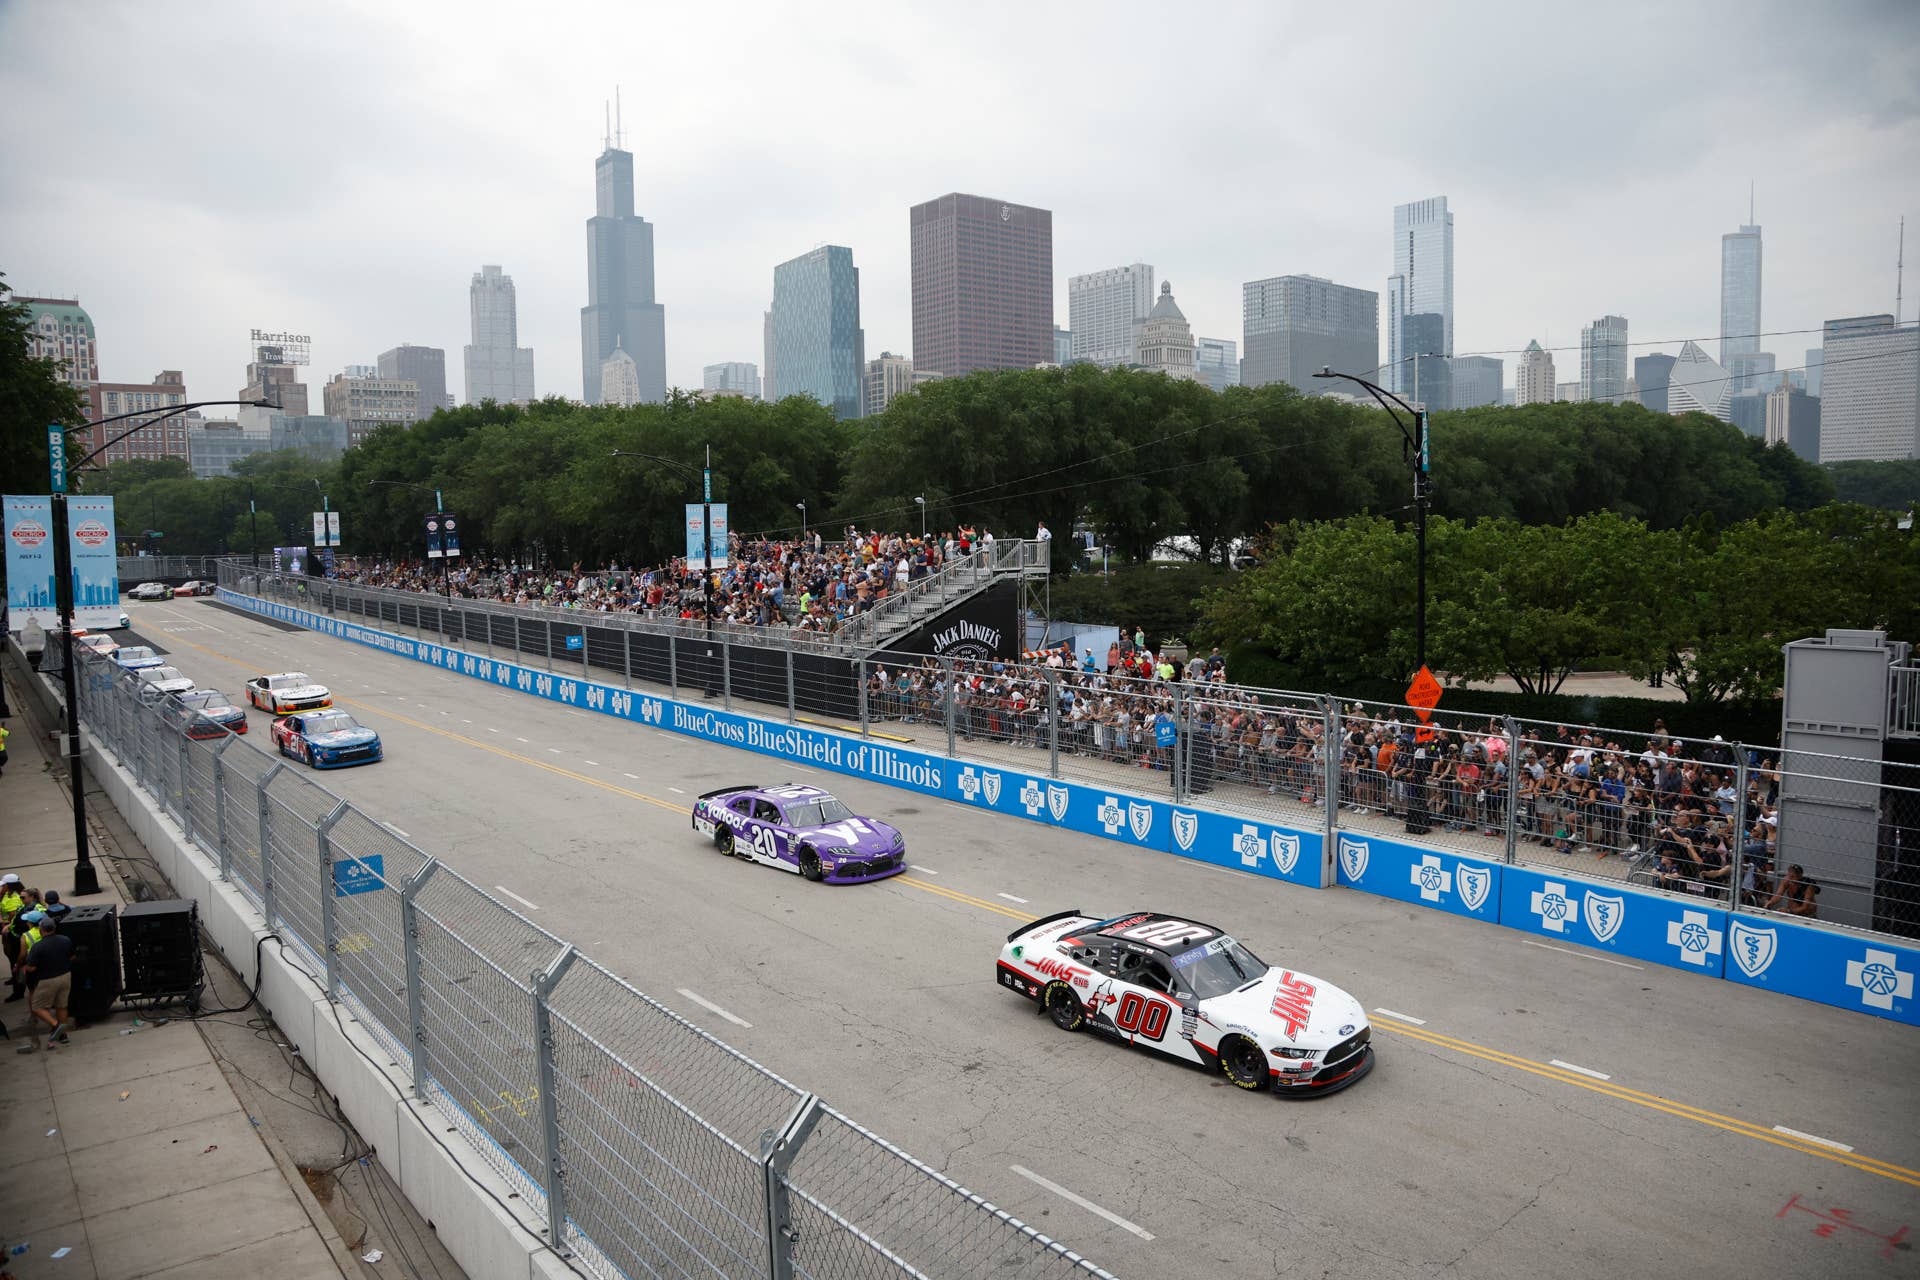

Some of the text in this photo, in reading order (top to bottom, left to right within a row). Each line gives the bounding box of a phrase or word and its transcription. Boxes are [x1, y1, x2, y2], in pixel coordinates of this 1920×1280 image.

[250, 329, 311, 343] Harrison
[49, 431, 63, 486] B341
[361, 631, 374, 644] ACCESS
[380, 635, 395, 649] BETTER
[396, 639, 413, 656] HEALTH
[933, 626, 960, 653] JACK
[960, 620, 1001, 650] DANIEL'S
[673, 705, 941, 790] BlueCross BlueShield of Illinois
[708, 804, 750, 831] yahoo!
[751, 824, 778, 859] 20
[1121, 920, 1215, 946] 00
[1179, 951, 1203, 966] xfinity
[1115, 990, 1172, 1042] 00
